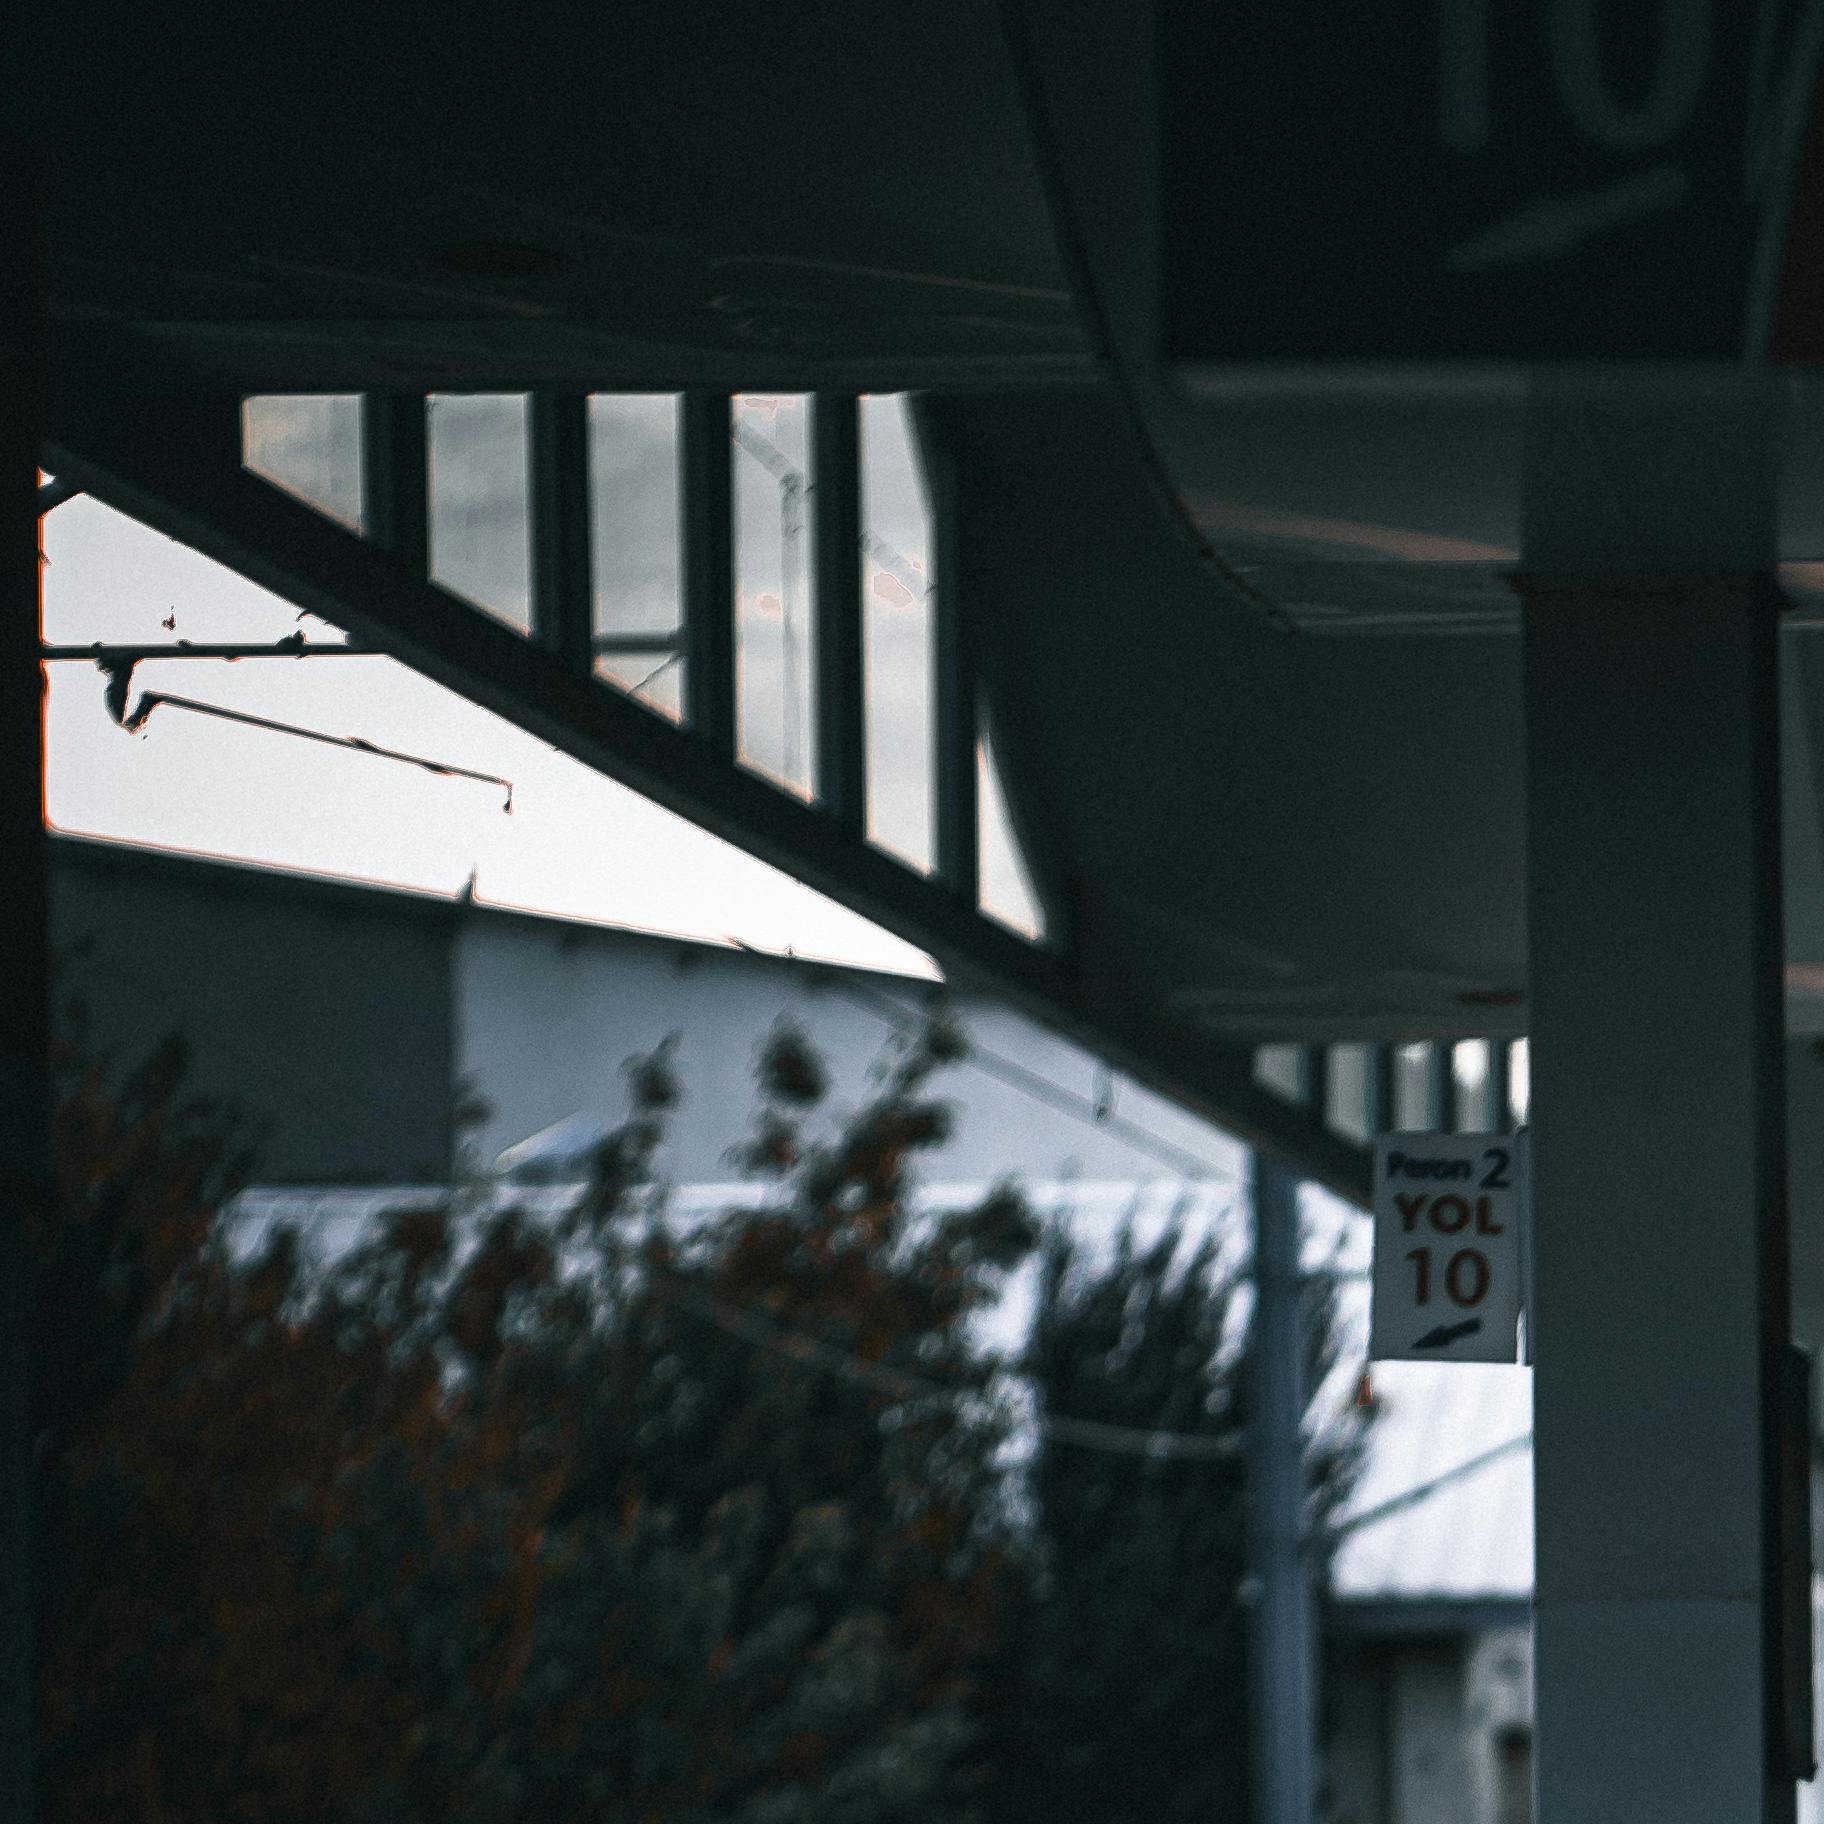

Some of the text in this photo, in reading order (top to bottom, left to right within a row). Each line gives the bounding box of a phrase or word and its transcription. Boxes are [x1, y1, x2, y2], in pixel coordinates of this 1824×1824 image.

[1479, 1148, 1510, 1189] 2
[1394, 1193, 1504, 1236] YOL
[1405, 1246, 1490, 1308] 10
